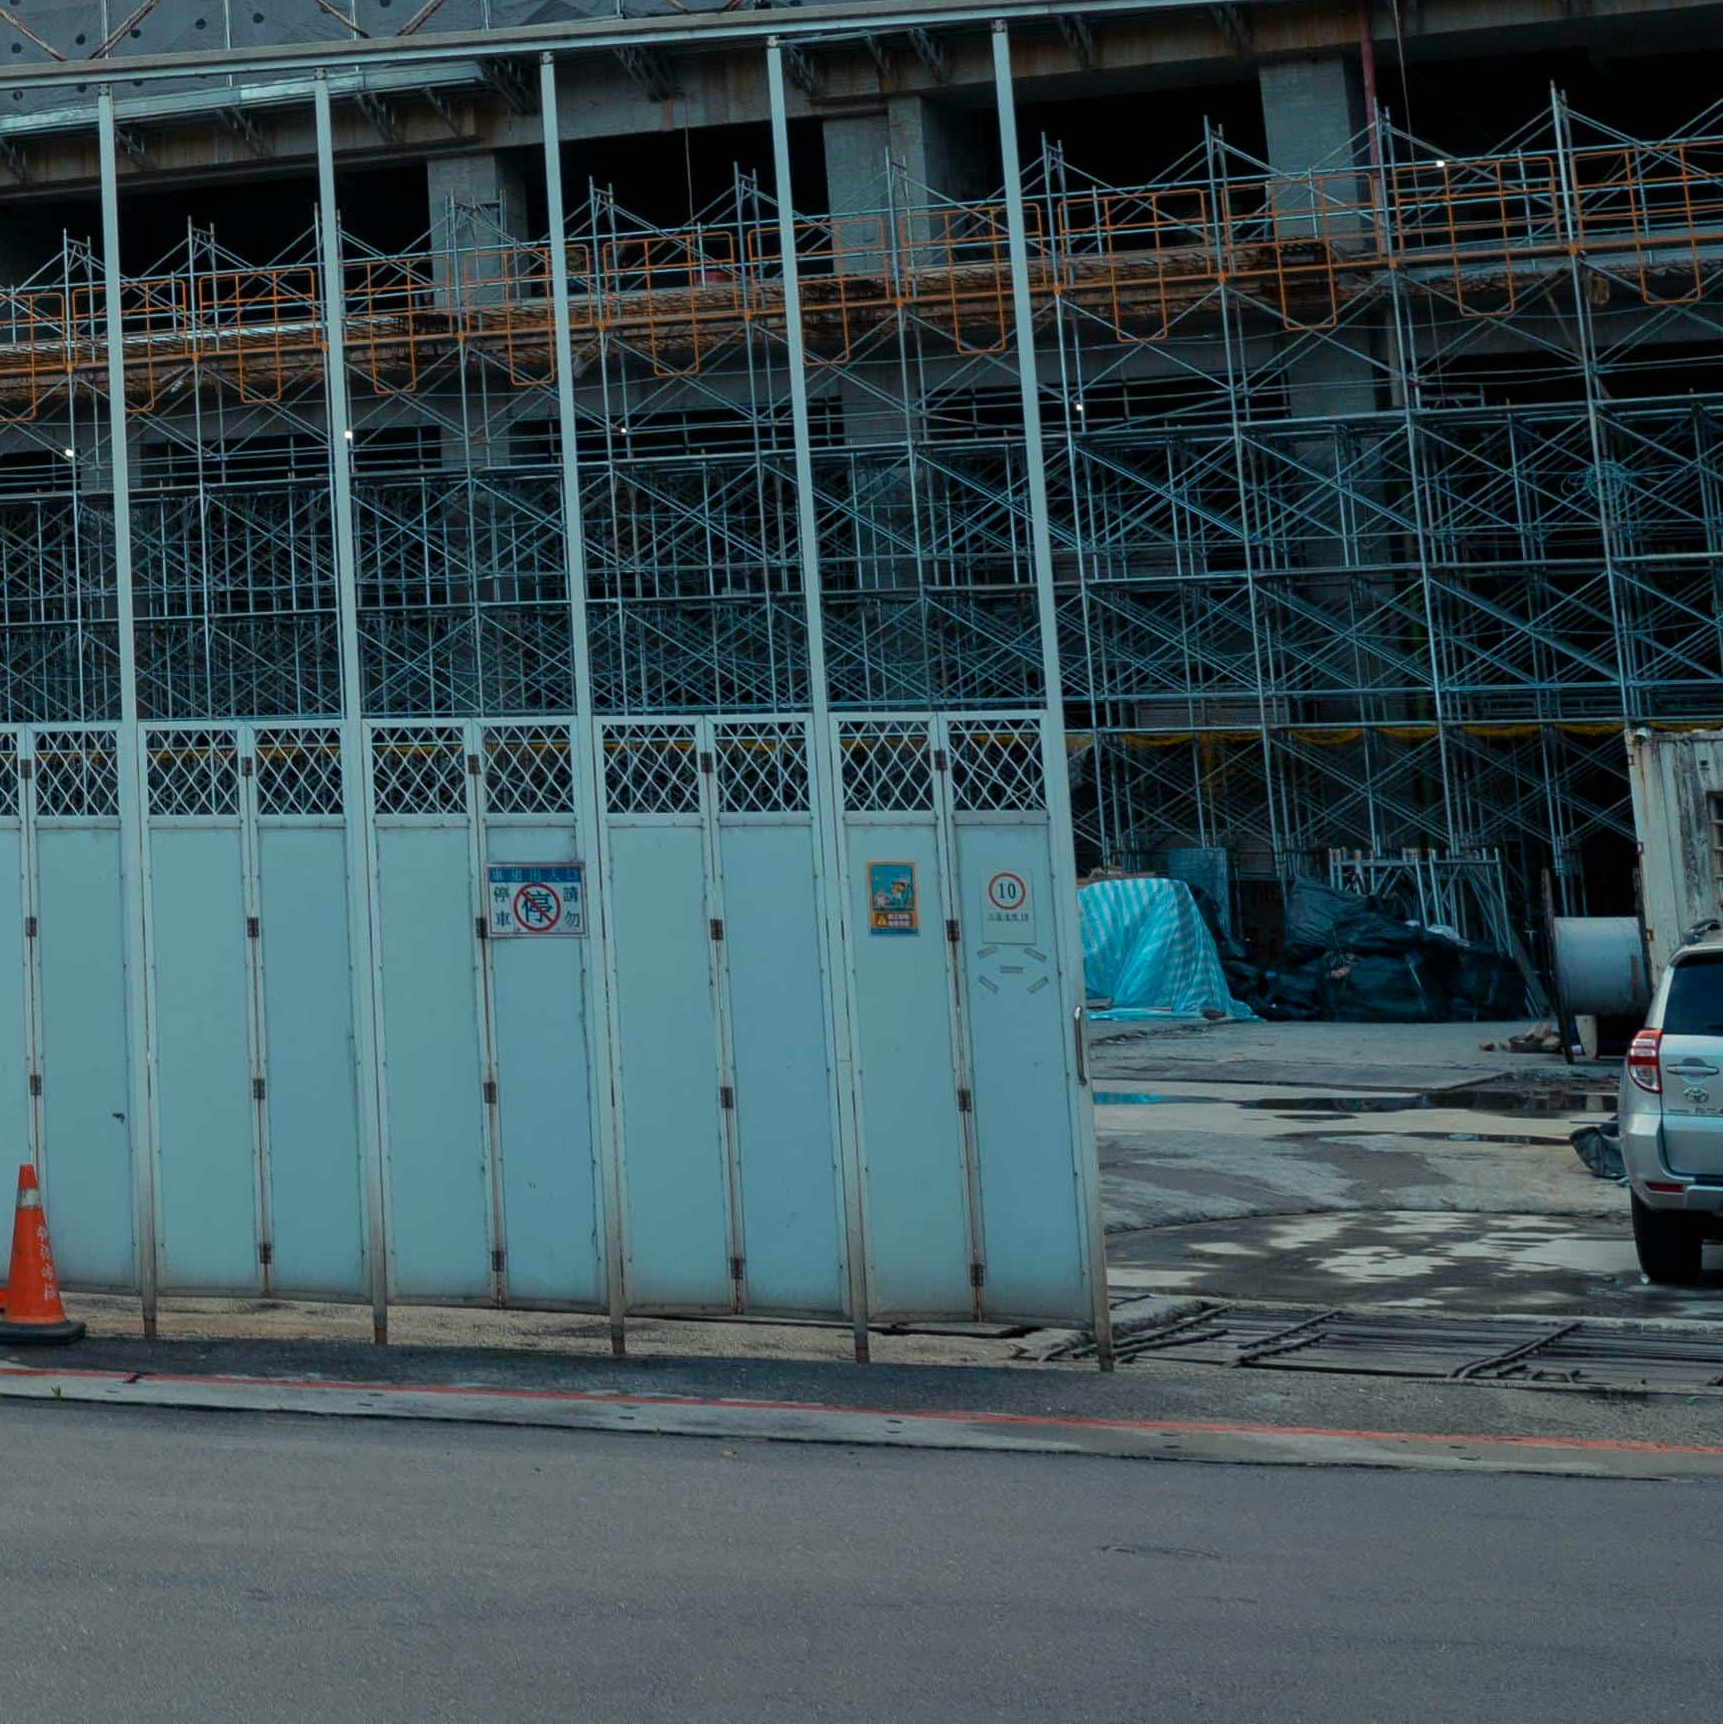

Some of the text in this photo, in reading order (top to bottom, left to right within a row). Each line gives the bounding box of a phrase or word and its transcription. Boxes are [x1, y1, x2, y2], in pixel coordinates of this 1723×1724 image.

[494, 886, 510, 927] 停車
[562, 886, 580, 927] 請勿
[999, 882, 1017, 899] 10
